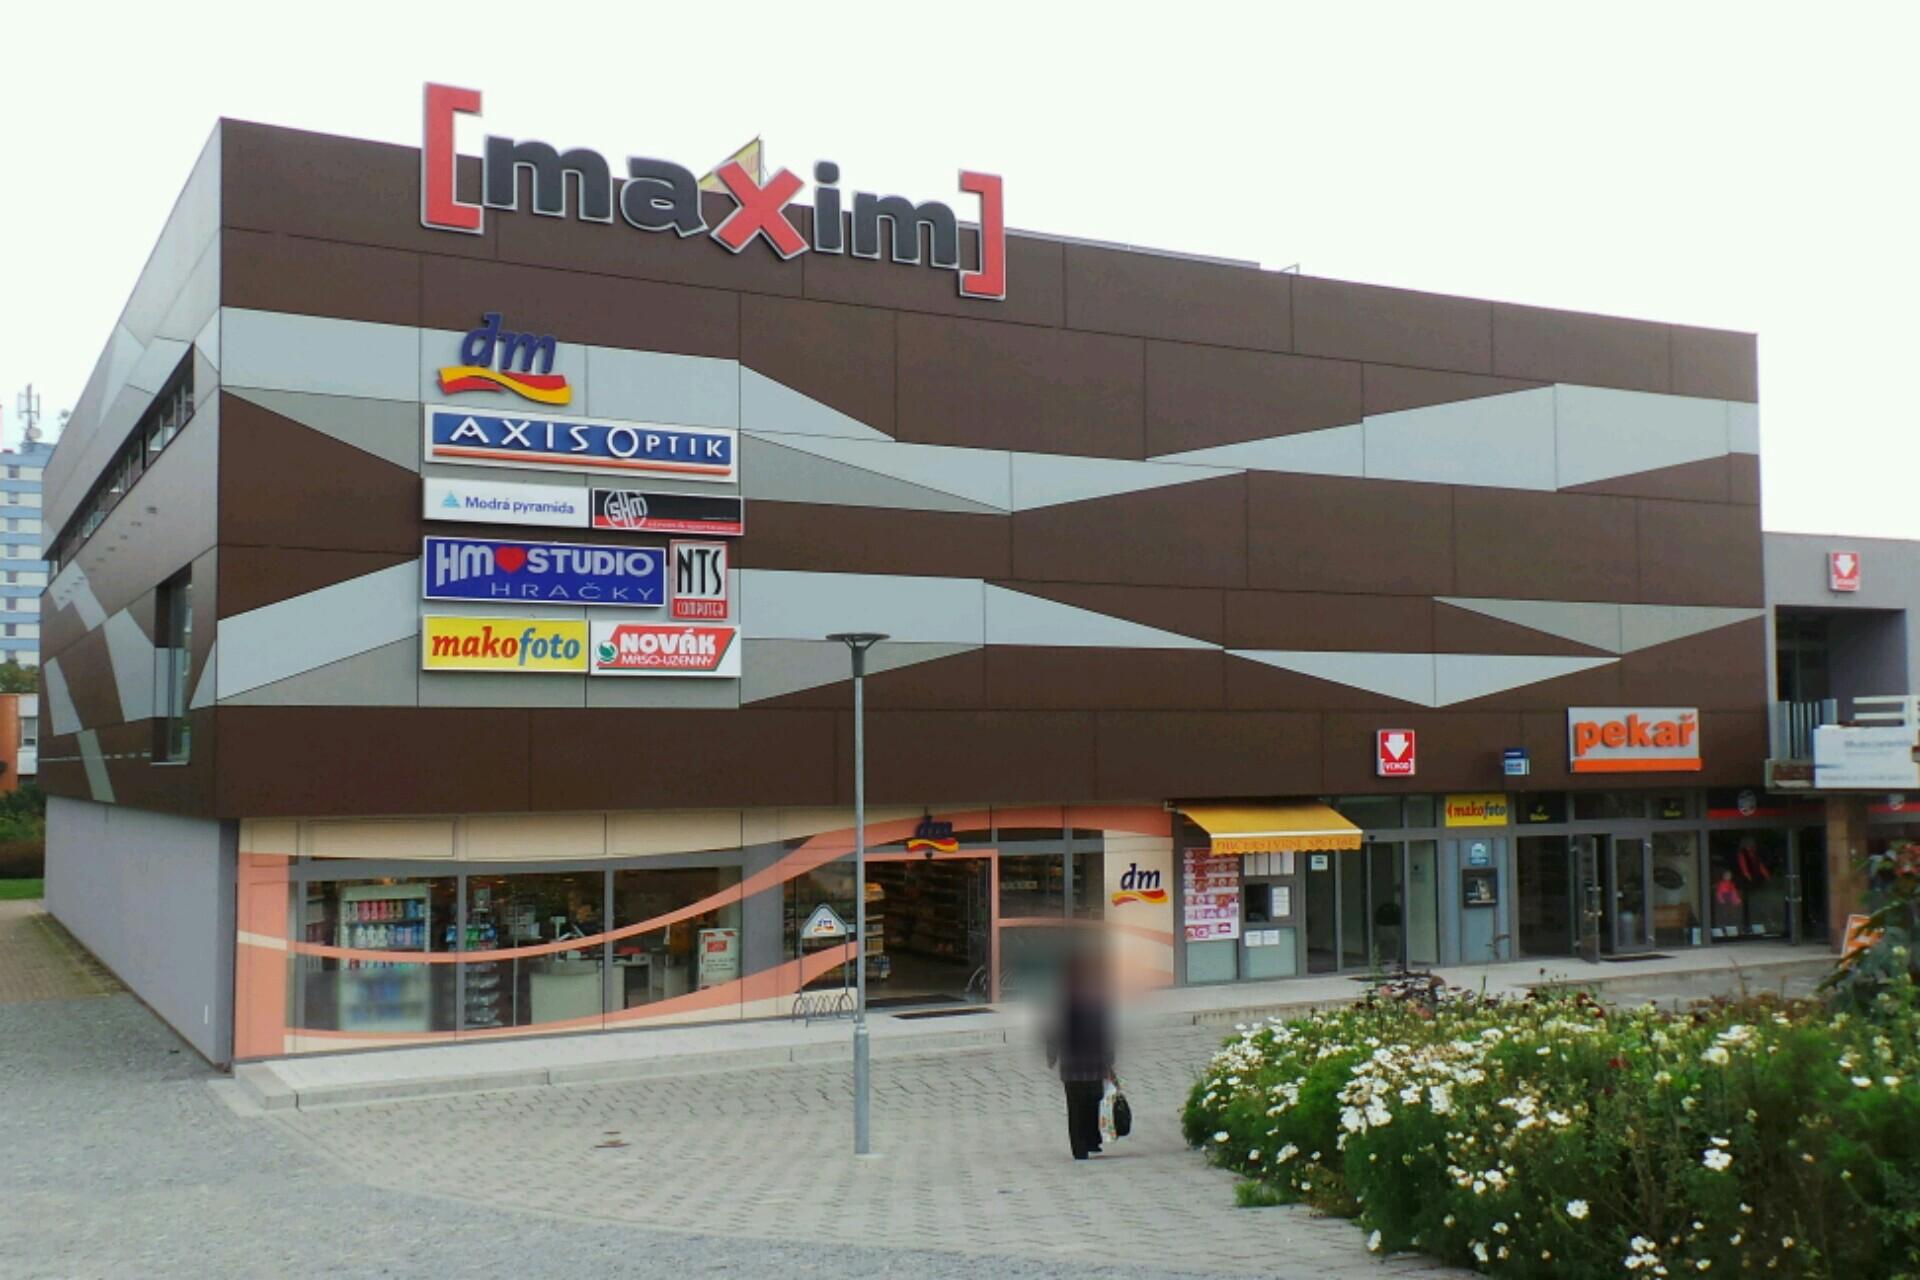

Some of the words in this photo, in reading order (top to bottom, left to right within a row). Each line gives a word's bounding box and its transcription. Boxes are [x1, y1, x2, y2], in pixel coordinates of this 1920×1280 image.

[460, 312, 556, 374] dm
[464, 496, 510, 511] Modrá
[512, 499, 576, 515] pyramida
[525, 548, 655, 578] STUDIO
[677, 546, 722, 596] NTS
[491, 581, 656, 600] HRAČKY
[431, 626, 580, 667] makofoto
[619, 628, 716, 655] NOVÁK
[1575, 713, 1697, 757] pekař
[1120, 863, 1161, 890] dm
